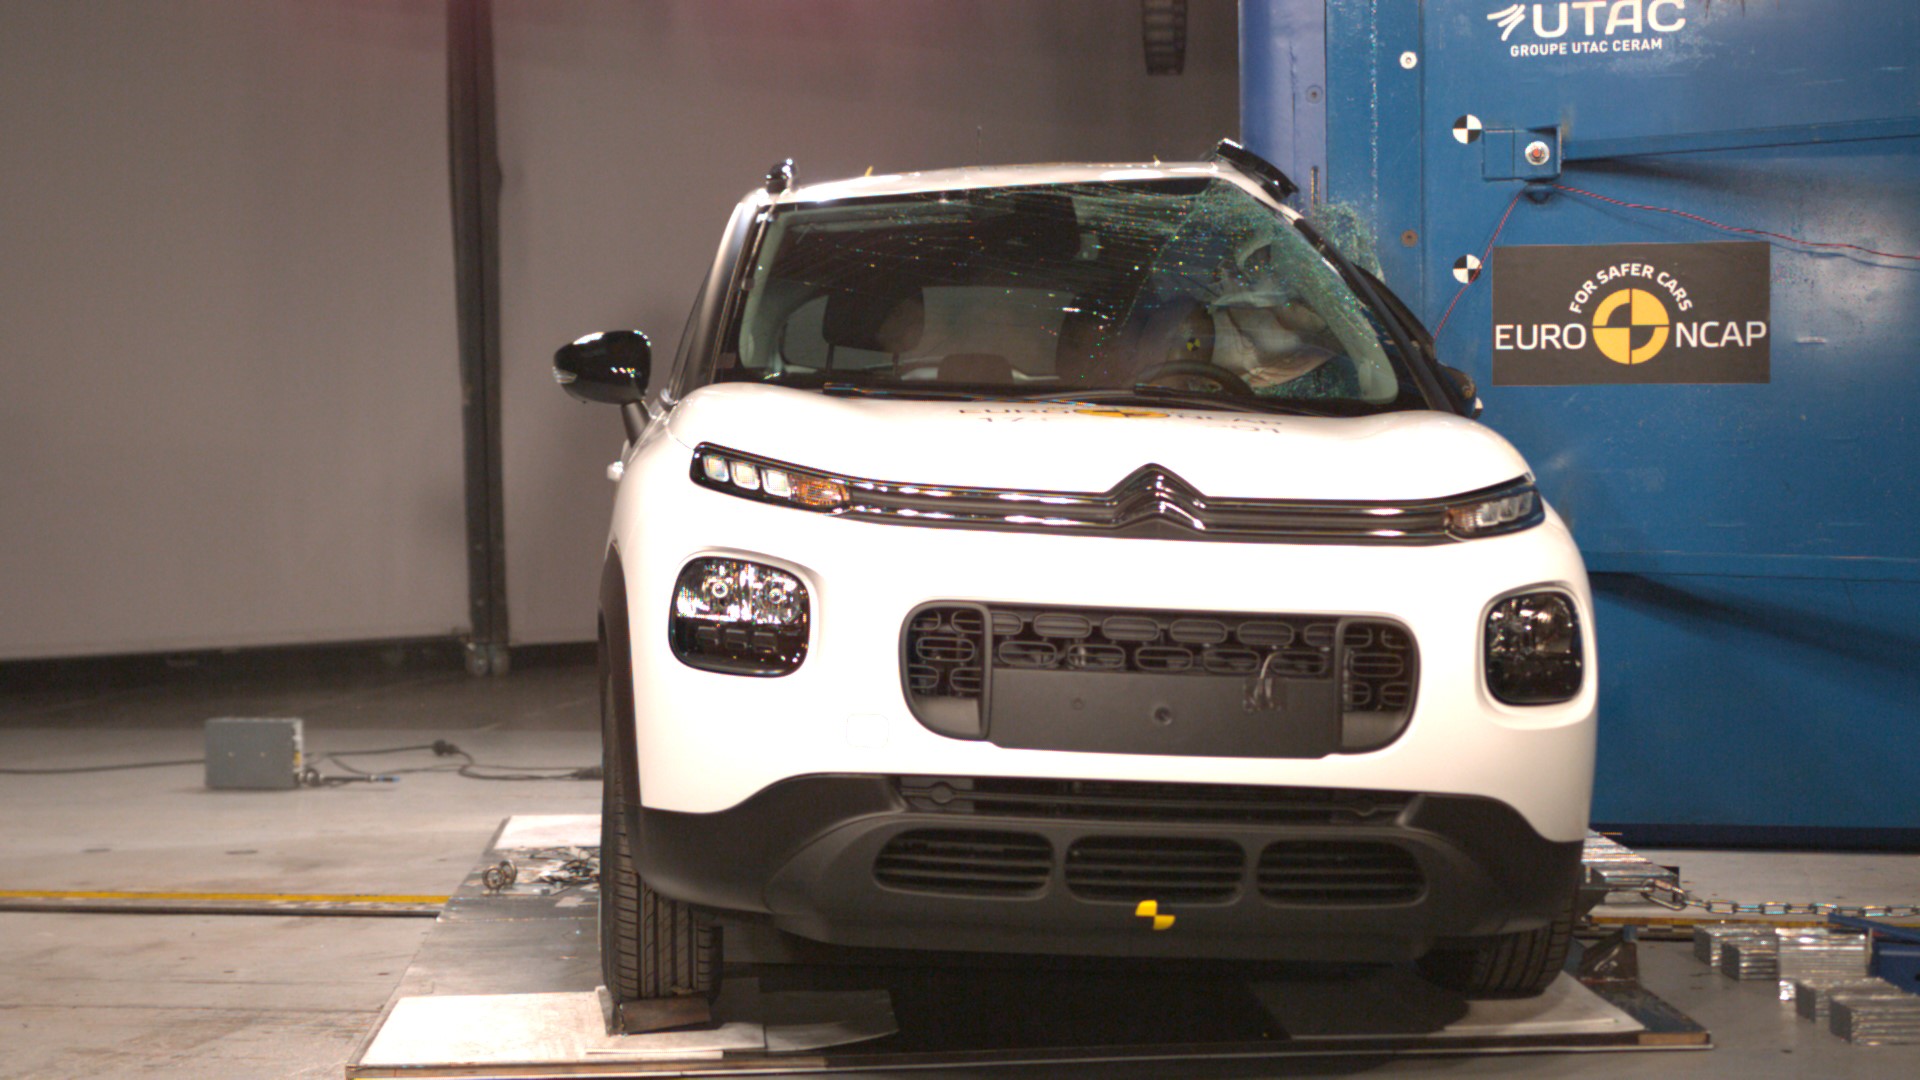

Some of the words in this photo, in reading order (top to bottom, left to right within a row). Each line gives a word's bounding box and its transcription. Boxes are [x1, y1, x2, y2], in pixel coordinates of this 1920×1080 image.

[1533, 0, 1686, 38] UTAC
[1510, 42, 1568, 57] GROUPE
[1572, 40, 1609, 54] UTAC
[1612, 38, 1663, 52] CERAM
[1569, 280, 1598, 314] FOR
[1596, 263, 1654, 285] SAFER
[1656, 271, 1693, 312] CARS
[1495, 323, 1587, 350] EURO
[1676, 321, 1767, 348] NCAP
